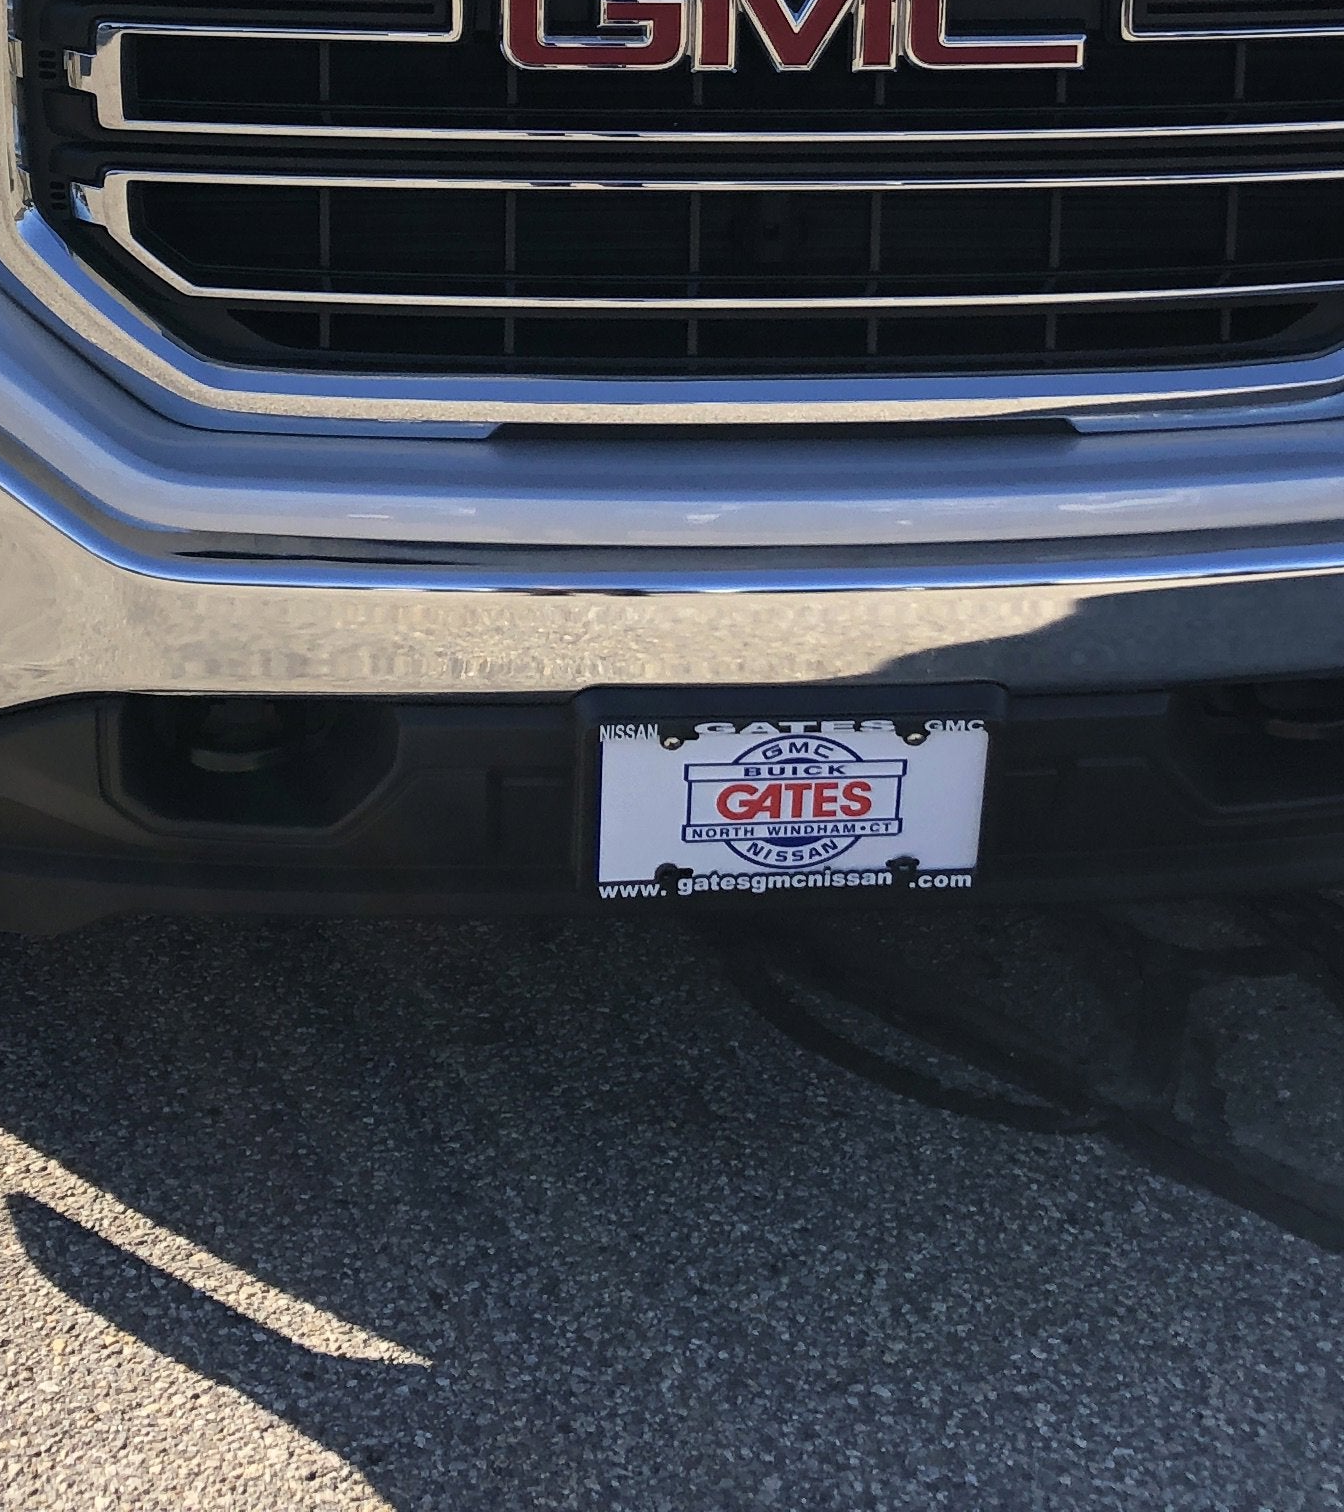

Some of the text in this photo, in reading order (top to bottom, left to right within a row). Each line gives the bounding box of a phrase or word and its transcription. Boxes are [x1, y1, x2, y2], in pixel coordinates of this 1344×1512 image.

[599, 719, 985, 742] NISSAN GATES GMC
[761, 741, 834, 761] GMC
[743, 764, 847, 777] BUICK
[715, 780, 873, 821] GATES
[691, 826, 755, 839] NORTH
[746, 838, 839, 863] NISSAN
[677, 869, 893, 896] gatesgmcnissan
